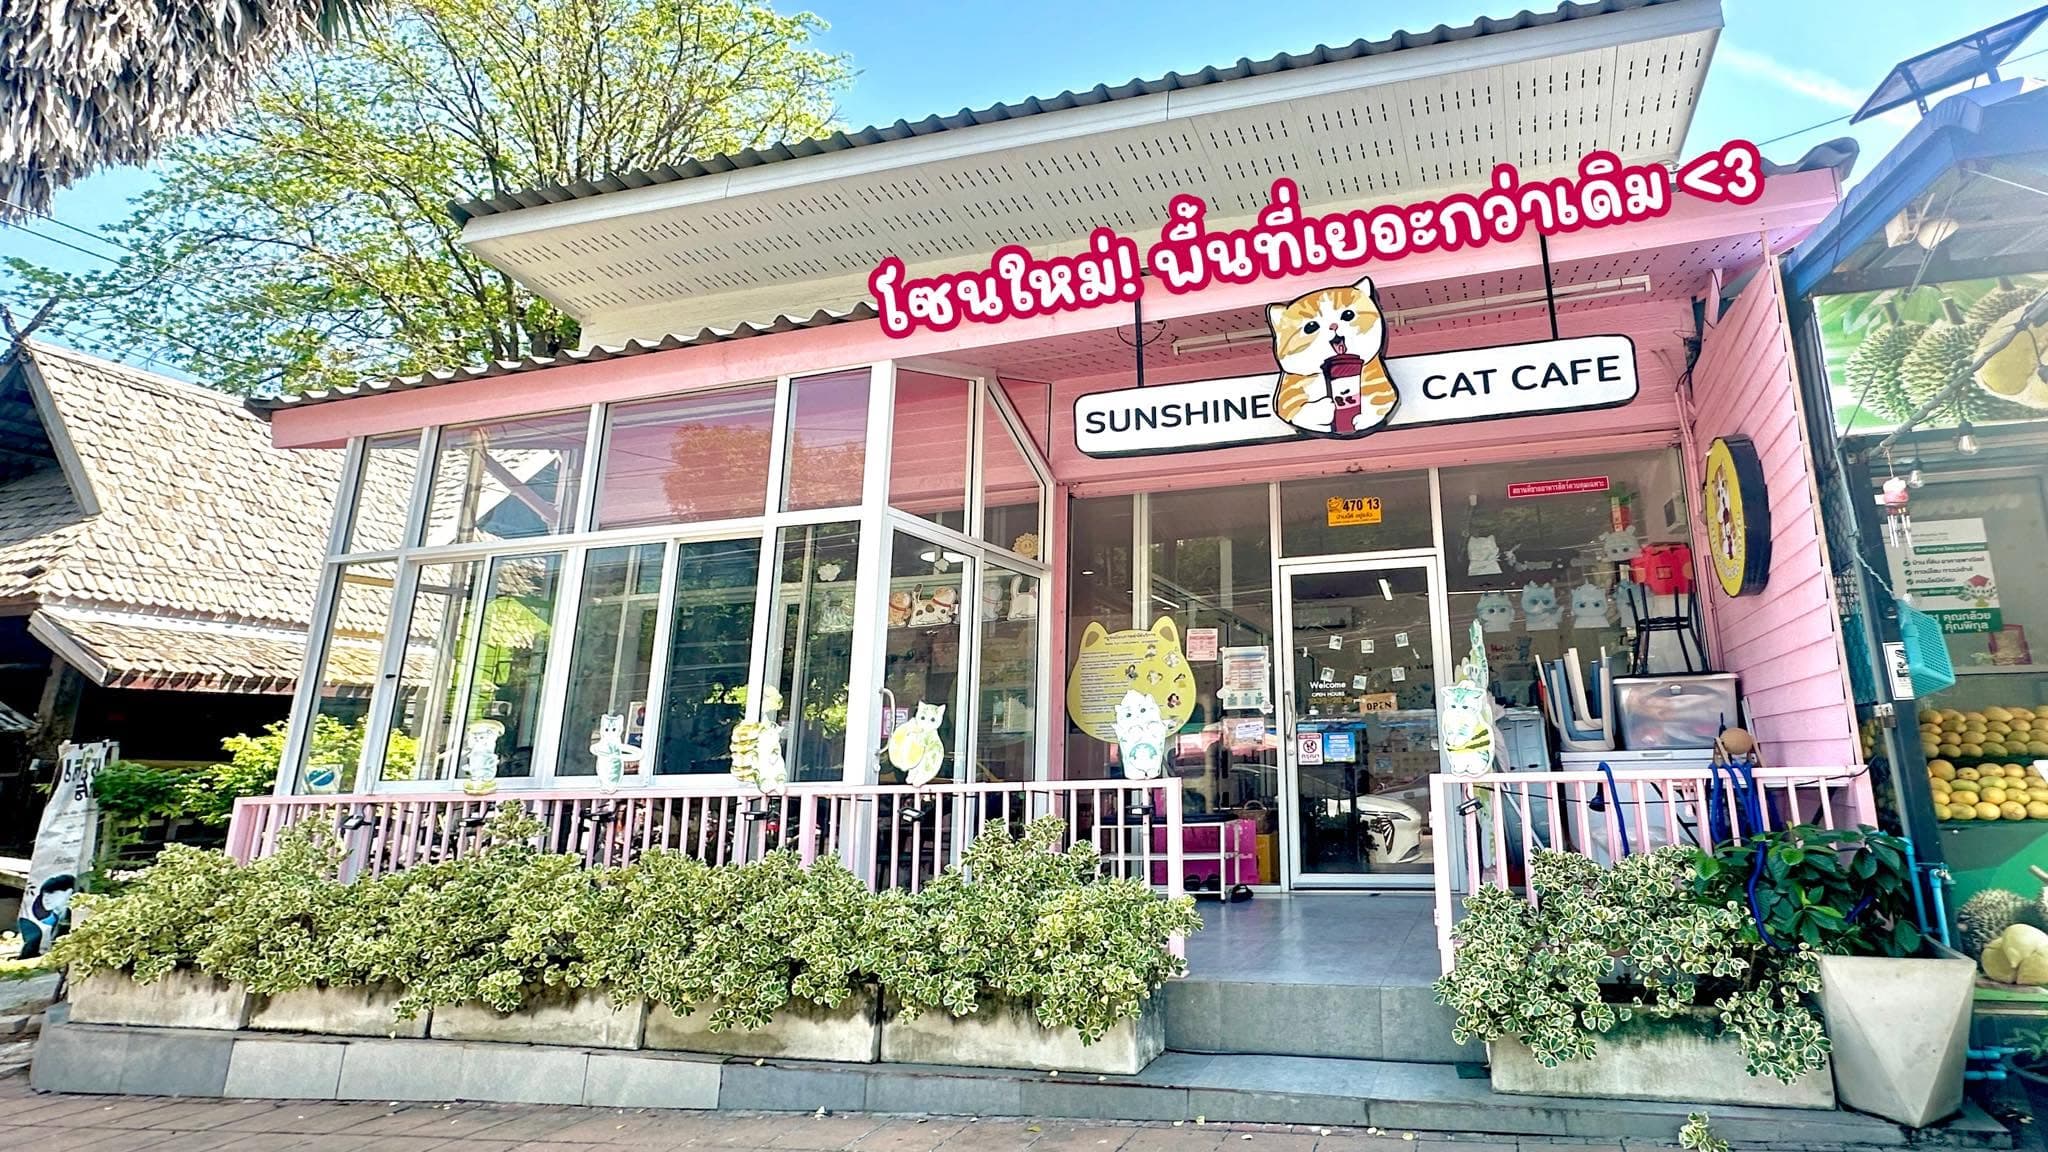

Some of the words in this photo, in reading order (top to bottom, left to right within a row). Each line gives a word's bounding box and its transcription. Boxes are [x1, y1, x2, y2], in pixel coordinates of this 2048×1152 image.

[1085, 394, 1272, 434] SUNSHINE
[1422, 369, 1498, 400] CAT
[1511, 355, 1621, 391] CAFE
[1943, 610, 1991, 623] คุณกล้วย
[1945, 621, 1989, 635] คุณพิกุล
[1309, 680, 1347, 690] Welcome
[1366, 701, 1392, 711] OPEN
